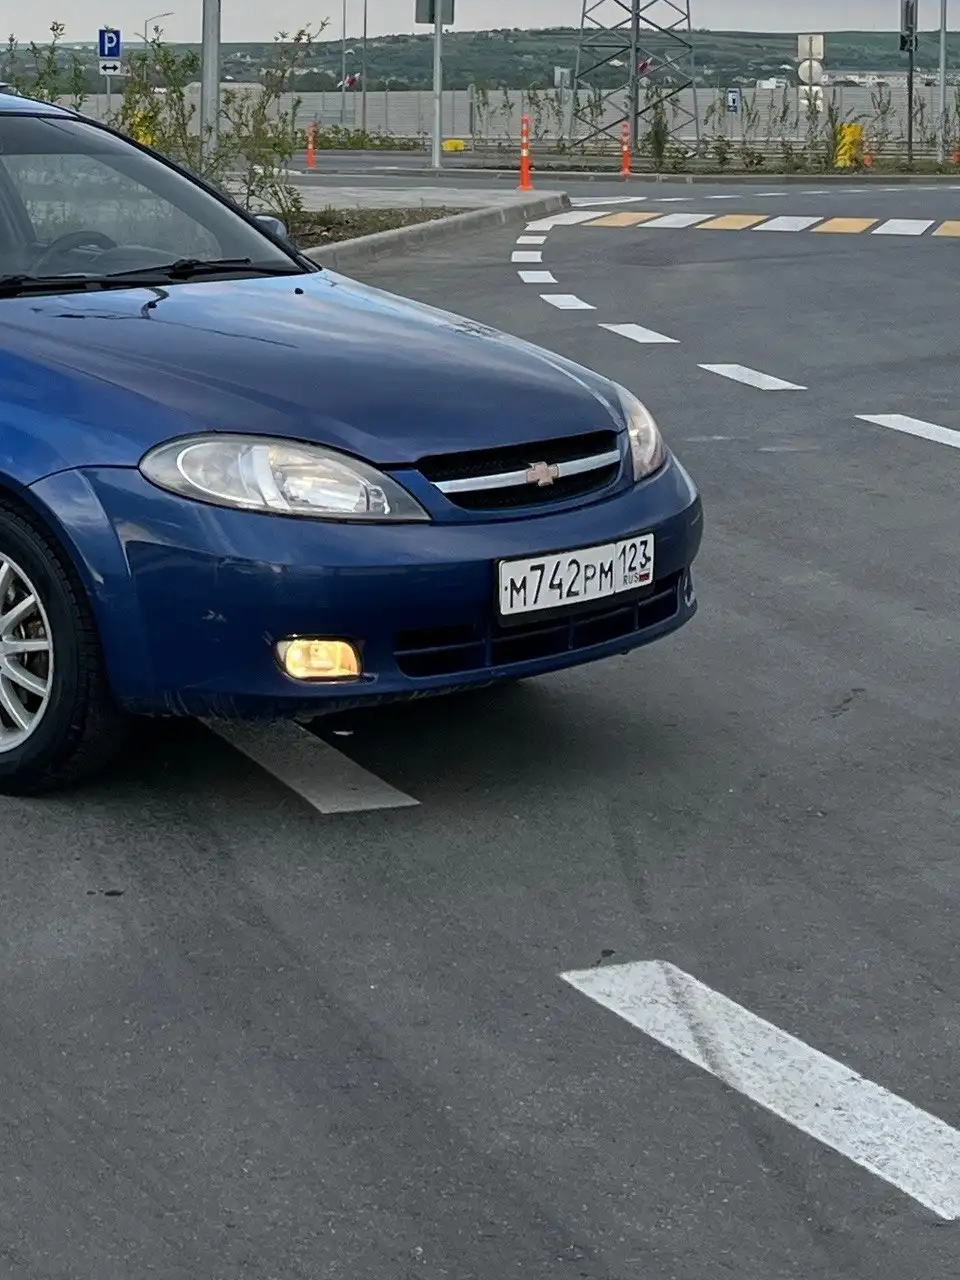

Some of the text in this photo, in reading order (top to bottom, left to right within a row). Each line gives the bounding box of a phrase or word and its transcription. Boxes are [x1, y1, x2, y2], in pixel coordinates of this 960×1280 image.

[104, 32, 117, 55] P
[618, 540, 651, 572] 123
[622, 572, 639, 586] RUS
